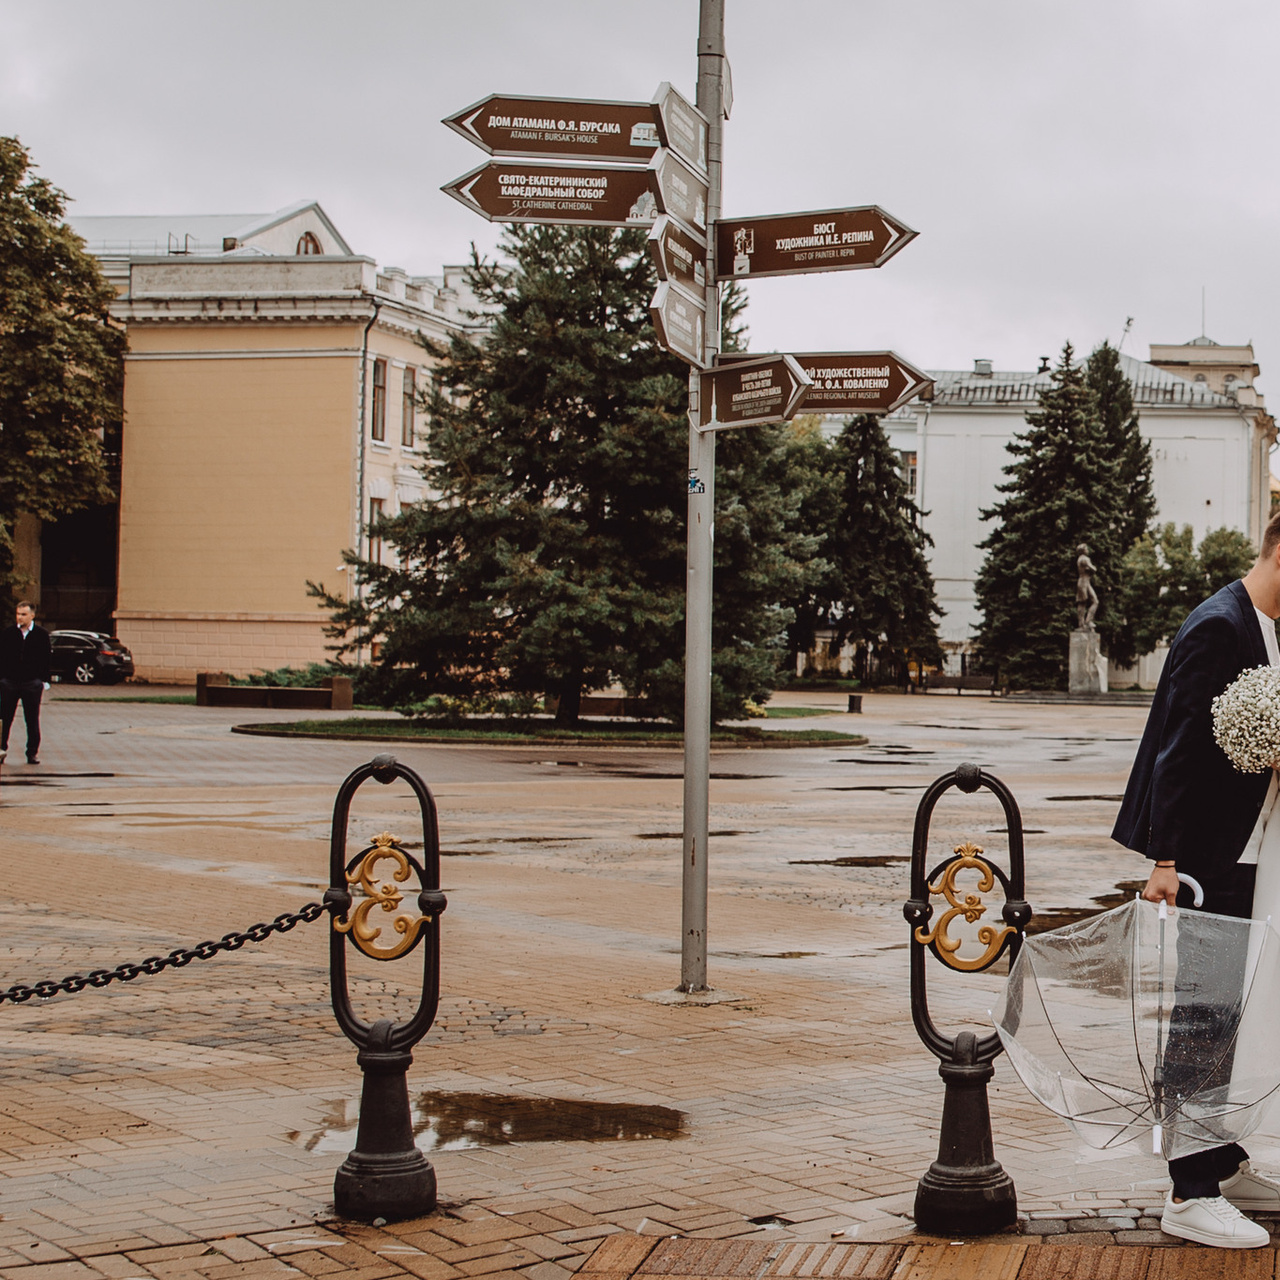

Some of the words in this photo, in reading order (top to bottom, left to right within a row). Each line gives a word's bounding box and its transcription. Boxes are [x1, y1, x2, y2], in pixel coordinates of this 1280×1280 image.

[488, 116, 510, 128] ДОМ
[512, 117, 556, 130] АТАМАНА
[557, 120, 578, 131] Ф.Я.
[580, 121, 621, 134] БУРСАКА
[510, 131, 537, 140] ATAMAN
[538, 132, 544, 140] F.
[545, 133, 575, 142] BURSAK'S
[577, 135, 598, 144] HOUSE
[498, 174, 608, 188] СВЯТО-ЕКАТЕРИНИНСКИЙ
[501, 186, 574, 198] КАФЕДРАЛЬНЫЙ
[577, 189, 605, 199] СОБОР
[522, 201, 556, 210] CATHERINE
[558, 202, 593, 211] CATHEDRAL
[814, 222, 836, 234] БЮСТ
[776, 235, 824, 250] ХУДОЖНИКА
[826, 233, 840, 245] И.Е.
[842, 230, 874, 244] РЕПИНА
[795, 252, 807, 261] BUST
[808, 252, 814, 260] OF
[815, 250, 835, 259] PAINTER
[840, 248, 855, 257] REPIN
[817, 366, 889, 379] ХУДОЖЕСТВЕННЫЙ
[825, 380, 842, 389] Ф.А.
[843, 379, 889, 389] КОВАЛЕНКО
